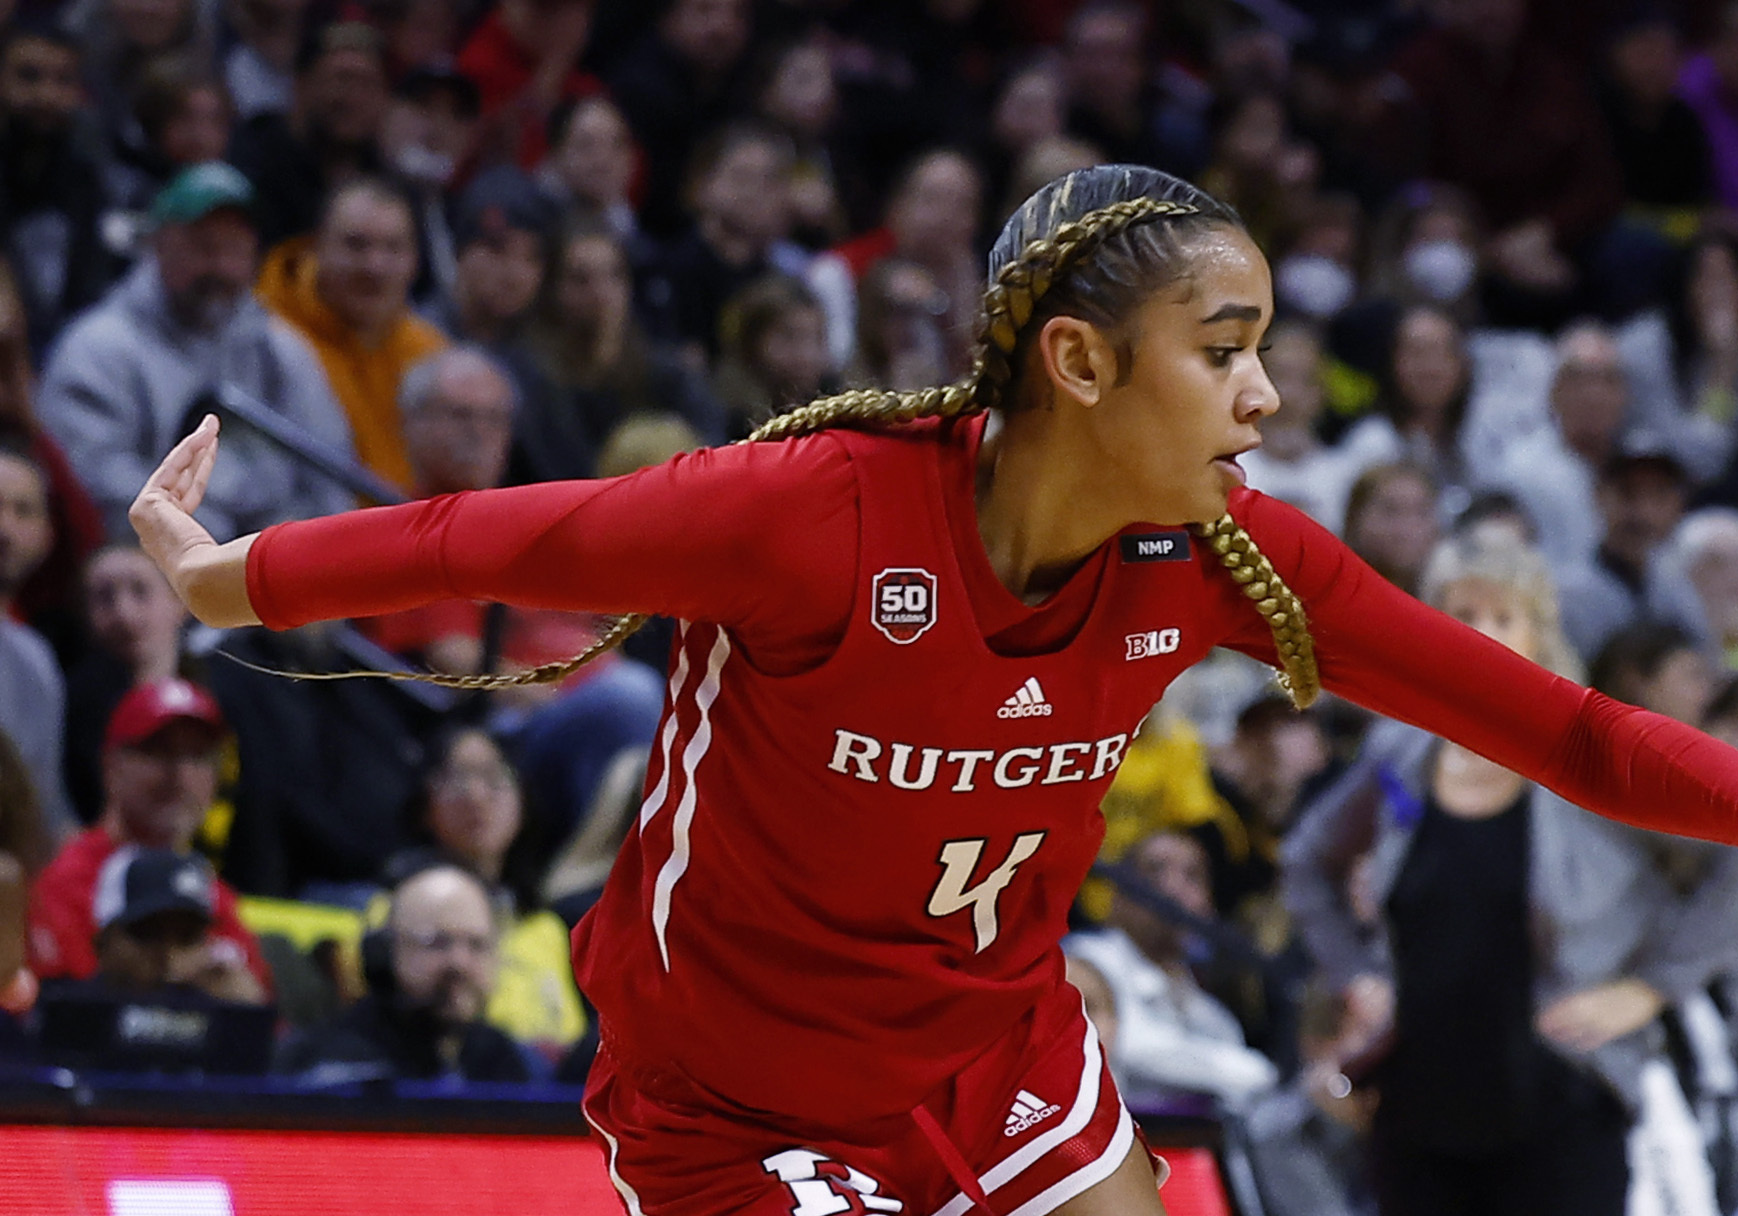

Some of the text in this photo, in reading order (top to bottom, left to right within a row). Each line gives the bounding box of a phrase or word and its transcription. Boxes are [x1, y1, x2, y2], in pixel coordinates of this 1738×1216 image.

[1137, 539, 1174, 556] NMP
[880, 584, 928, 612] 50
[996, 702, 1053, 719] adidas
[827, 714, 1149, 792] RUTGER
[926, 831, 1047, 954] 4
[1003, 1103, 1061, 1137] adidas
